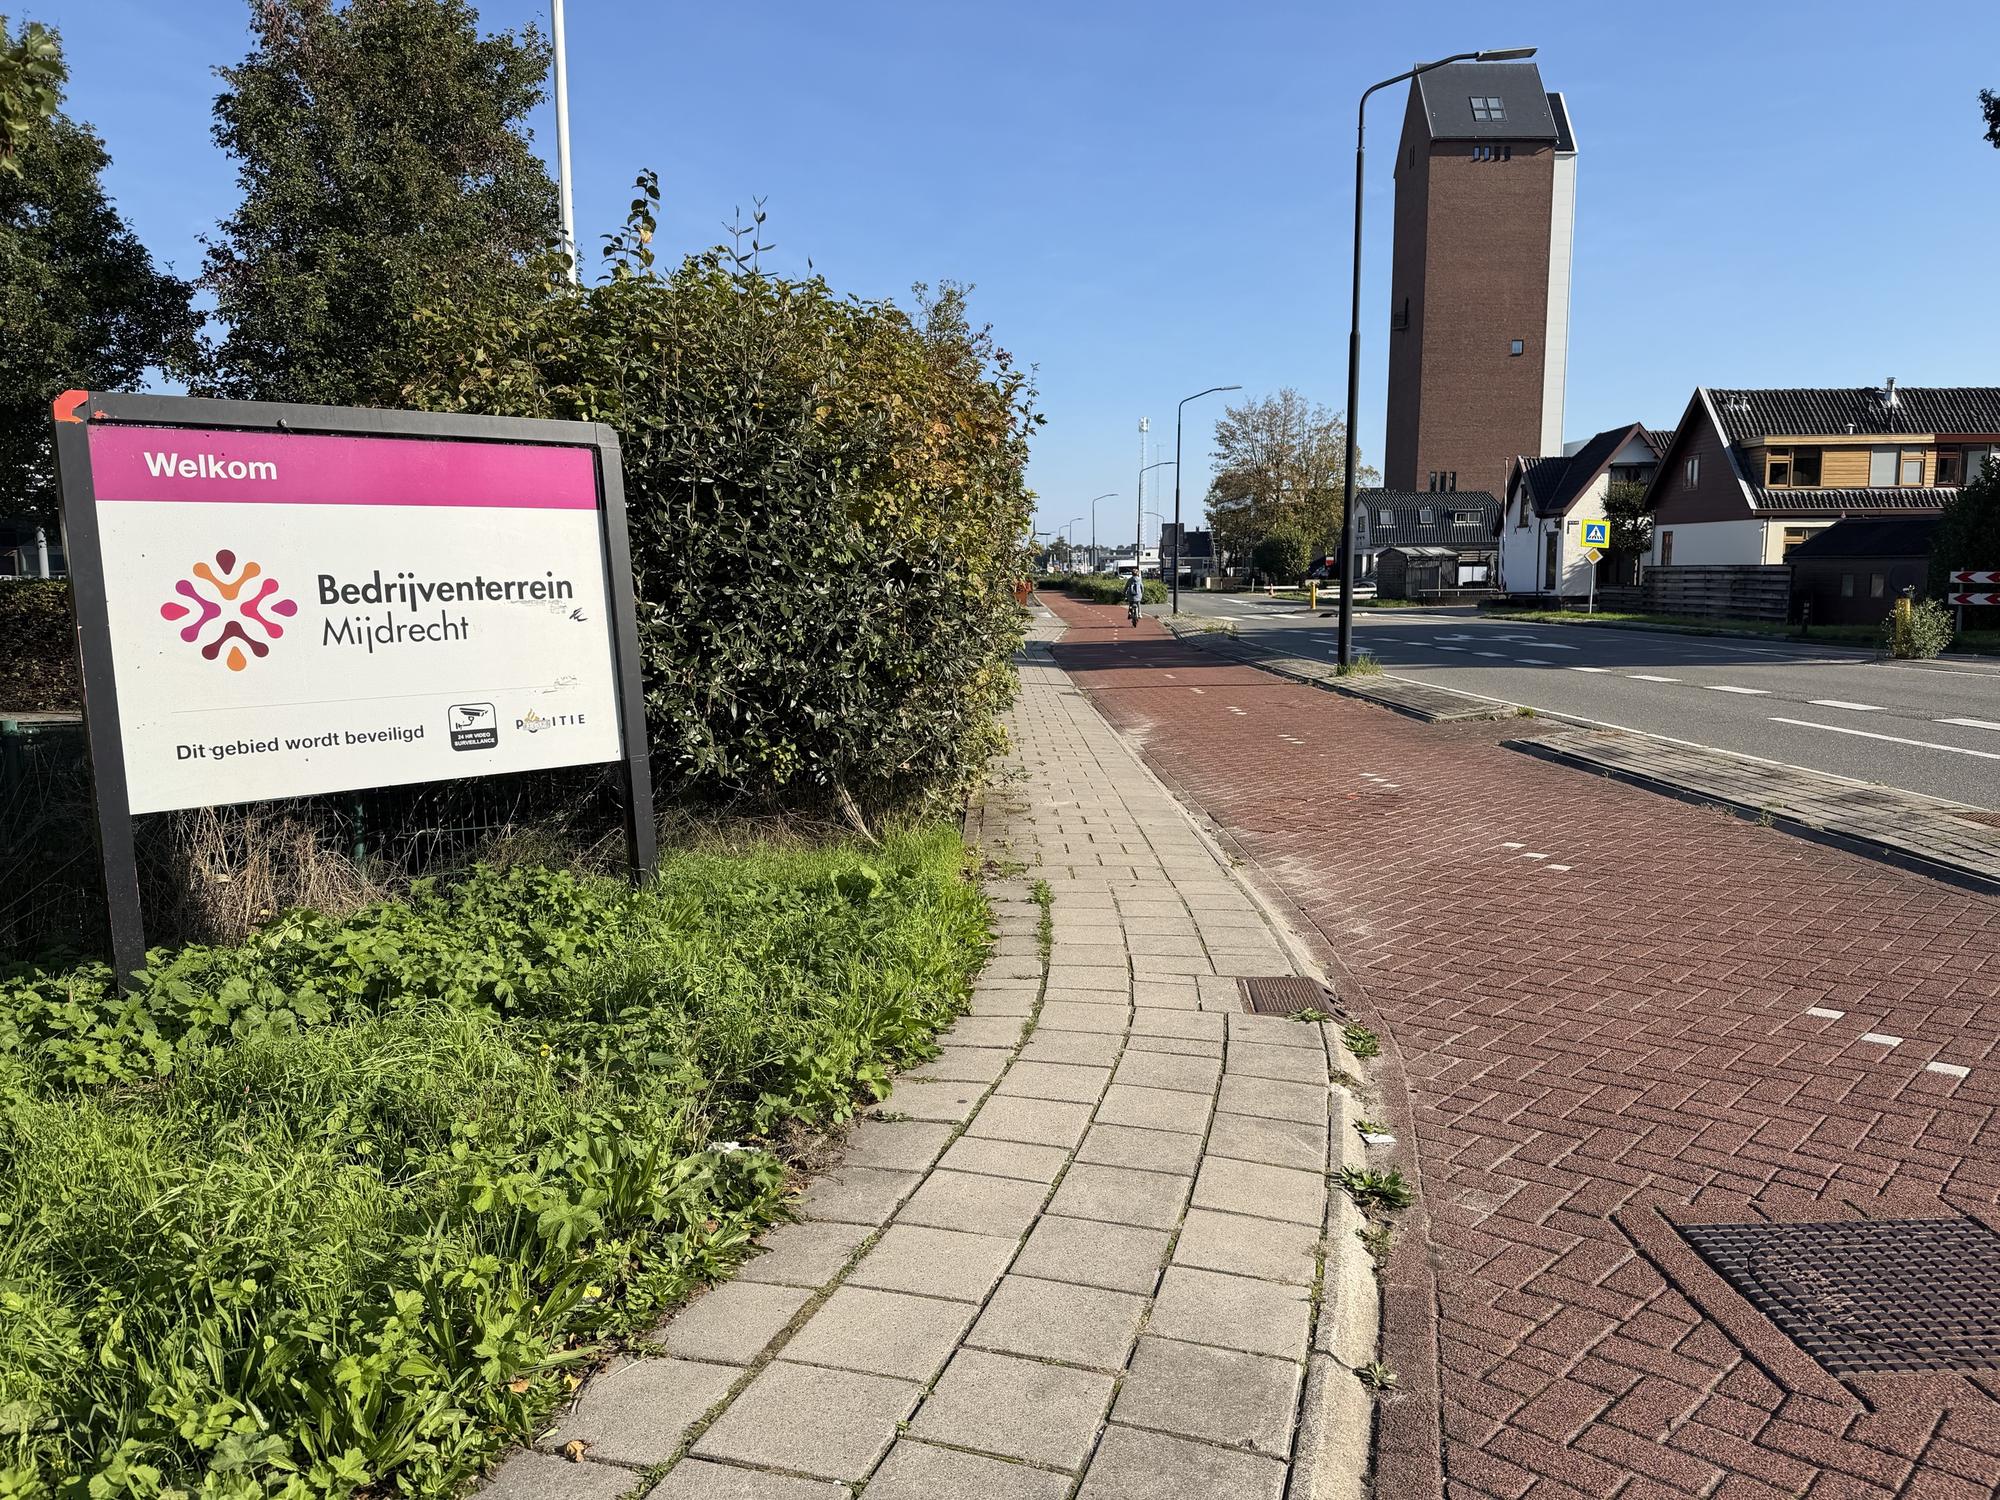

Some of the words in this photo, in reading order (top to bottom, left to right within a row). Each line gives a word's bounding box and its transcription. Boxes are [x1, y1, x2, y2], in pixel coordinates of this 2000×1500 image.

[143, 452, 278, 480] Welkom
[317, 570, 574, 613] Bedrijventerrein
[322, 610, 470, 654] Mijdrecht
[515, 714, 585, 733] PITIE
[176, 743, 206, 760] Dit
[208, 737, 279, 761] gebied
[284, 732, 340, 750] wordt
[344, 724, 424, 746] beveiligd
[454, 737, 495, 746] SURVEILLANCE
